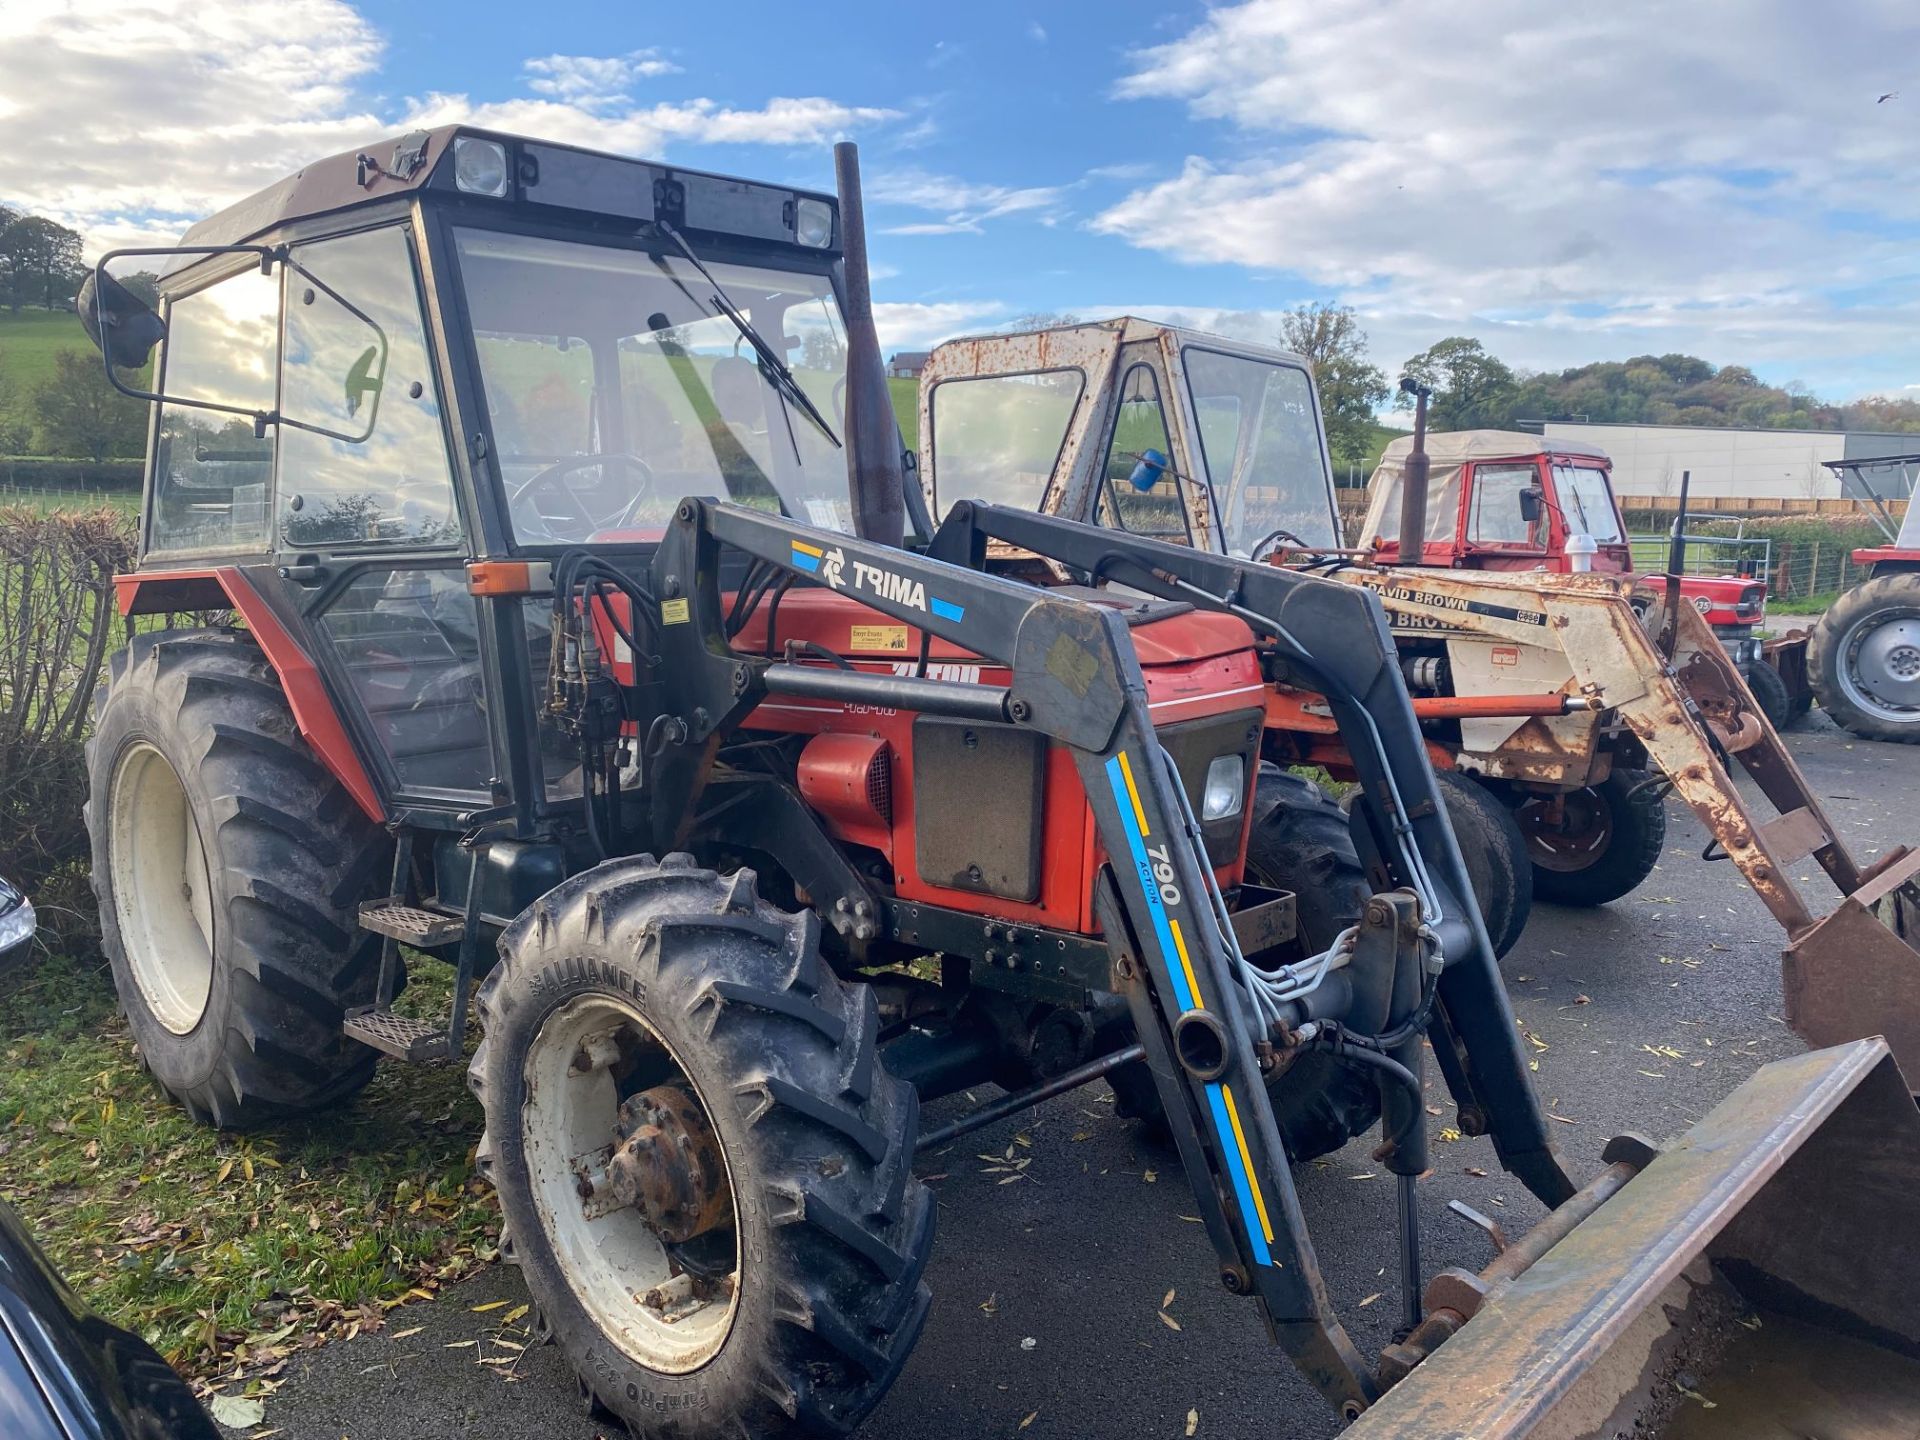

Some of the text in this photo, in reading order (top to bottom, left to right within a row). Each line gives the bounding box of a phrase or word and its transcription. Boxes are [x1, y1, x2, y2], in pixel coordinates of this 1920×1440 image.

[853, 561, 926, 612] TRIMA
[1367, 582, 1411, 601] DAVID
[1414, 591, 1469, 611] BROWN
[1396, 611, 1466, 629] BRO
[1138, 860, 1159, 904] ACTION
[1147, 844, 1181, 906] 790
[542, 955, 647, 1013] ALLIANCE
[624, 1381, 711, 1415] FarmPRO
